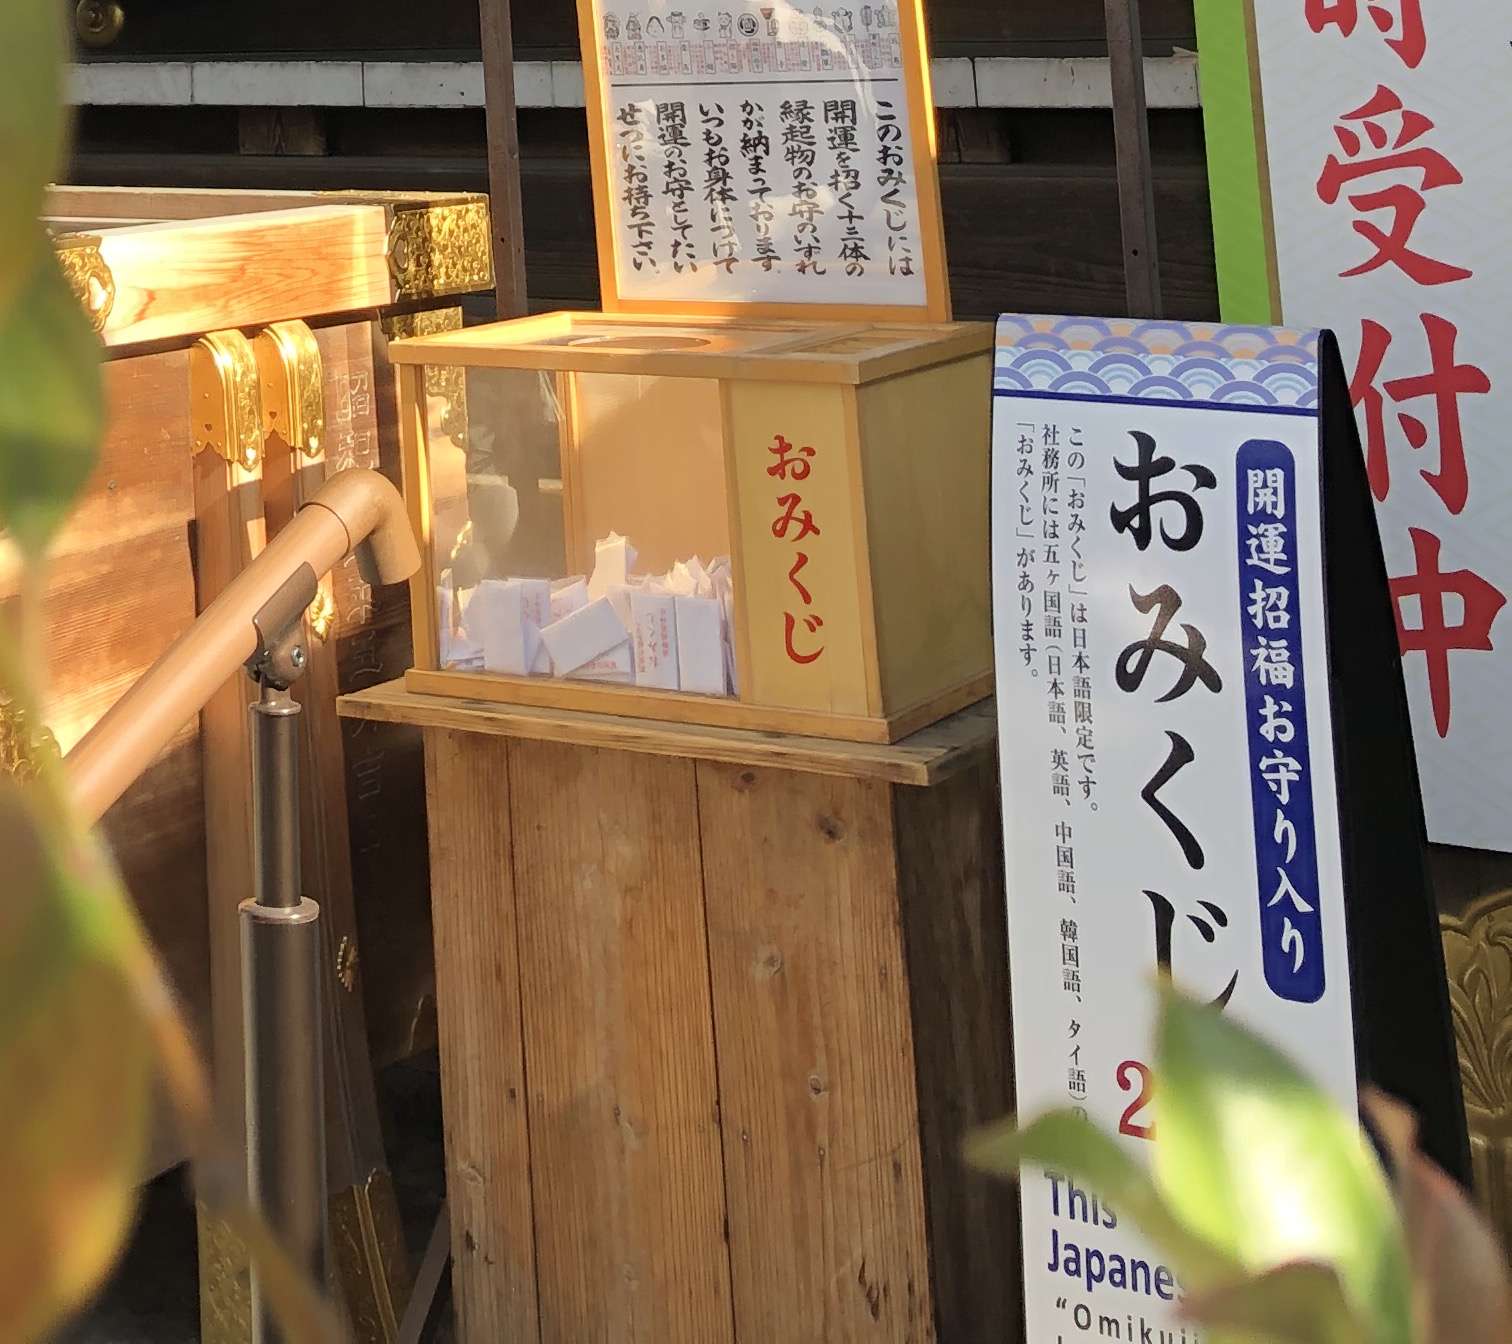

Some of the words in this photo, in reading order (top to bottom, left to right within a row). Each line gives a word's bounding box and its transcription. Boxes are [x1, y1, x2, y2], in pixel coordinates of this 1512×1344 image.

[616, 103, 660, 276] せつにお持ち下さい。
[656, 101, 698, 275] 開運のお守としてたい
[699, 103, 739, 275] いつもお身体につけて
[739, 100, 782, 276] かが納まっております。
[780, 100, 826, 276] 縁起物のお守のいずれ
[823, 100, 870, 278] 開運を招く十三体の
[875, 101, 915, 278] このおみくじには
[766, 434, 825, 665] おみくじ
[1015, 421, 1039, 679] 「おみくじ」があります。
[1066, 426, 1099, 812] この「おみくじ」は日本語限定です。
[1040, 423, 1088, 1118] 社務所には五ヶ国語(日本語、英語、中国語、韓国語、タイ語)
[1246, 468, 1315, 974] 開運招福お守り入り
